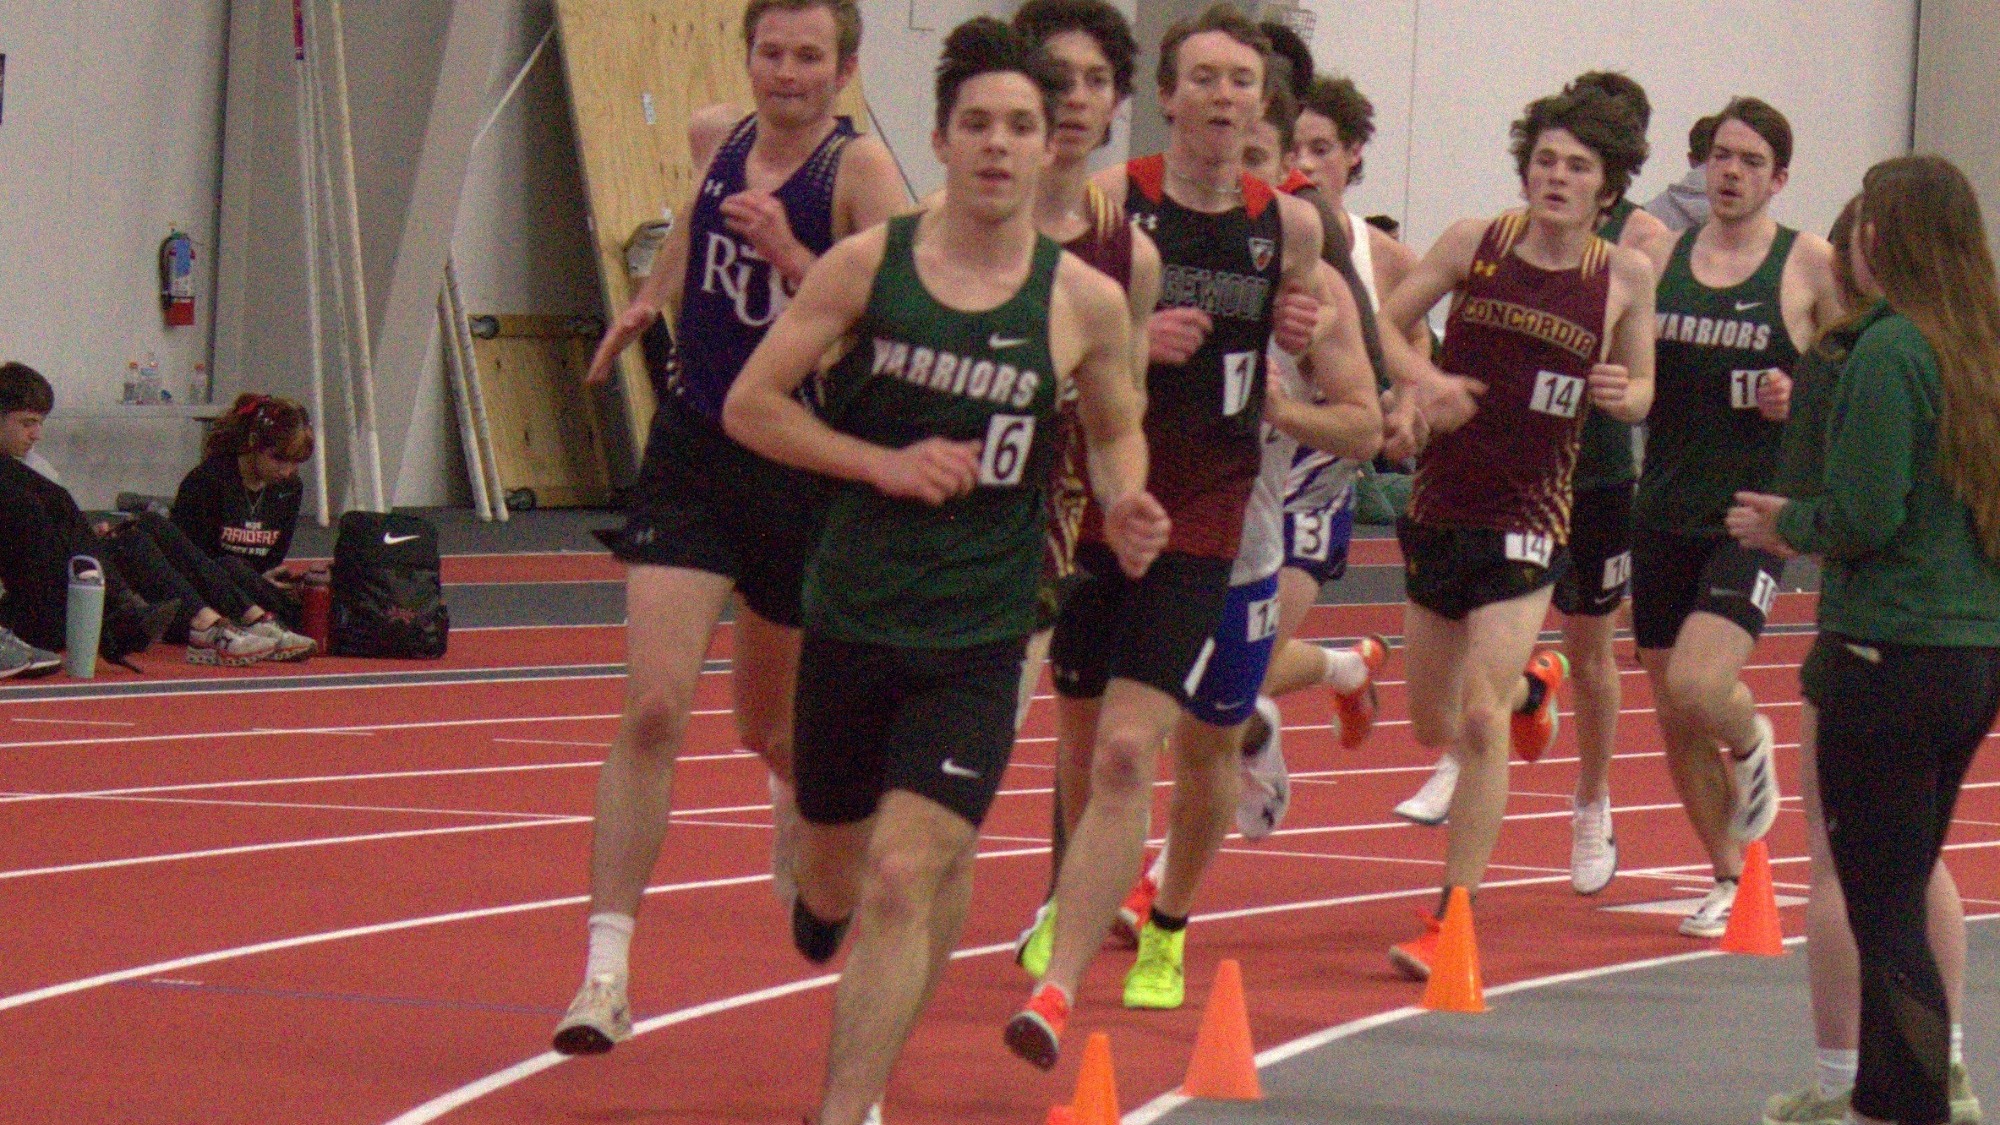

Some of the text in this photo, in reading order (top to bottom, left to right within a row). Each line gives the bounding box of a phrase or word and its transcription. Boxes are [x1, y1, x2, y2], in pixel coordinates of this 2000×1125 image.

[1543, 376, 1575, 414] 14
[993, 420, 1024, 480] 6
[1301, 510, 1323, 556] 3
[1521, 532, 1549, 561] 14
